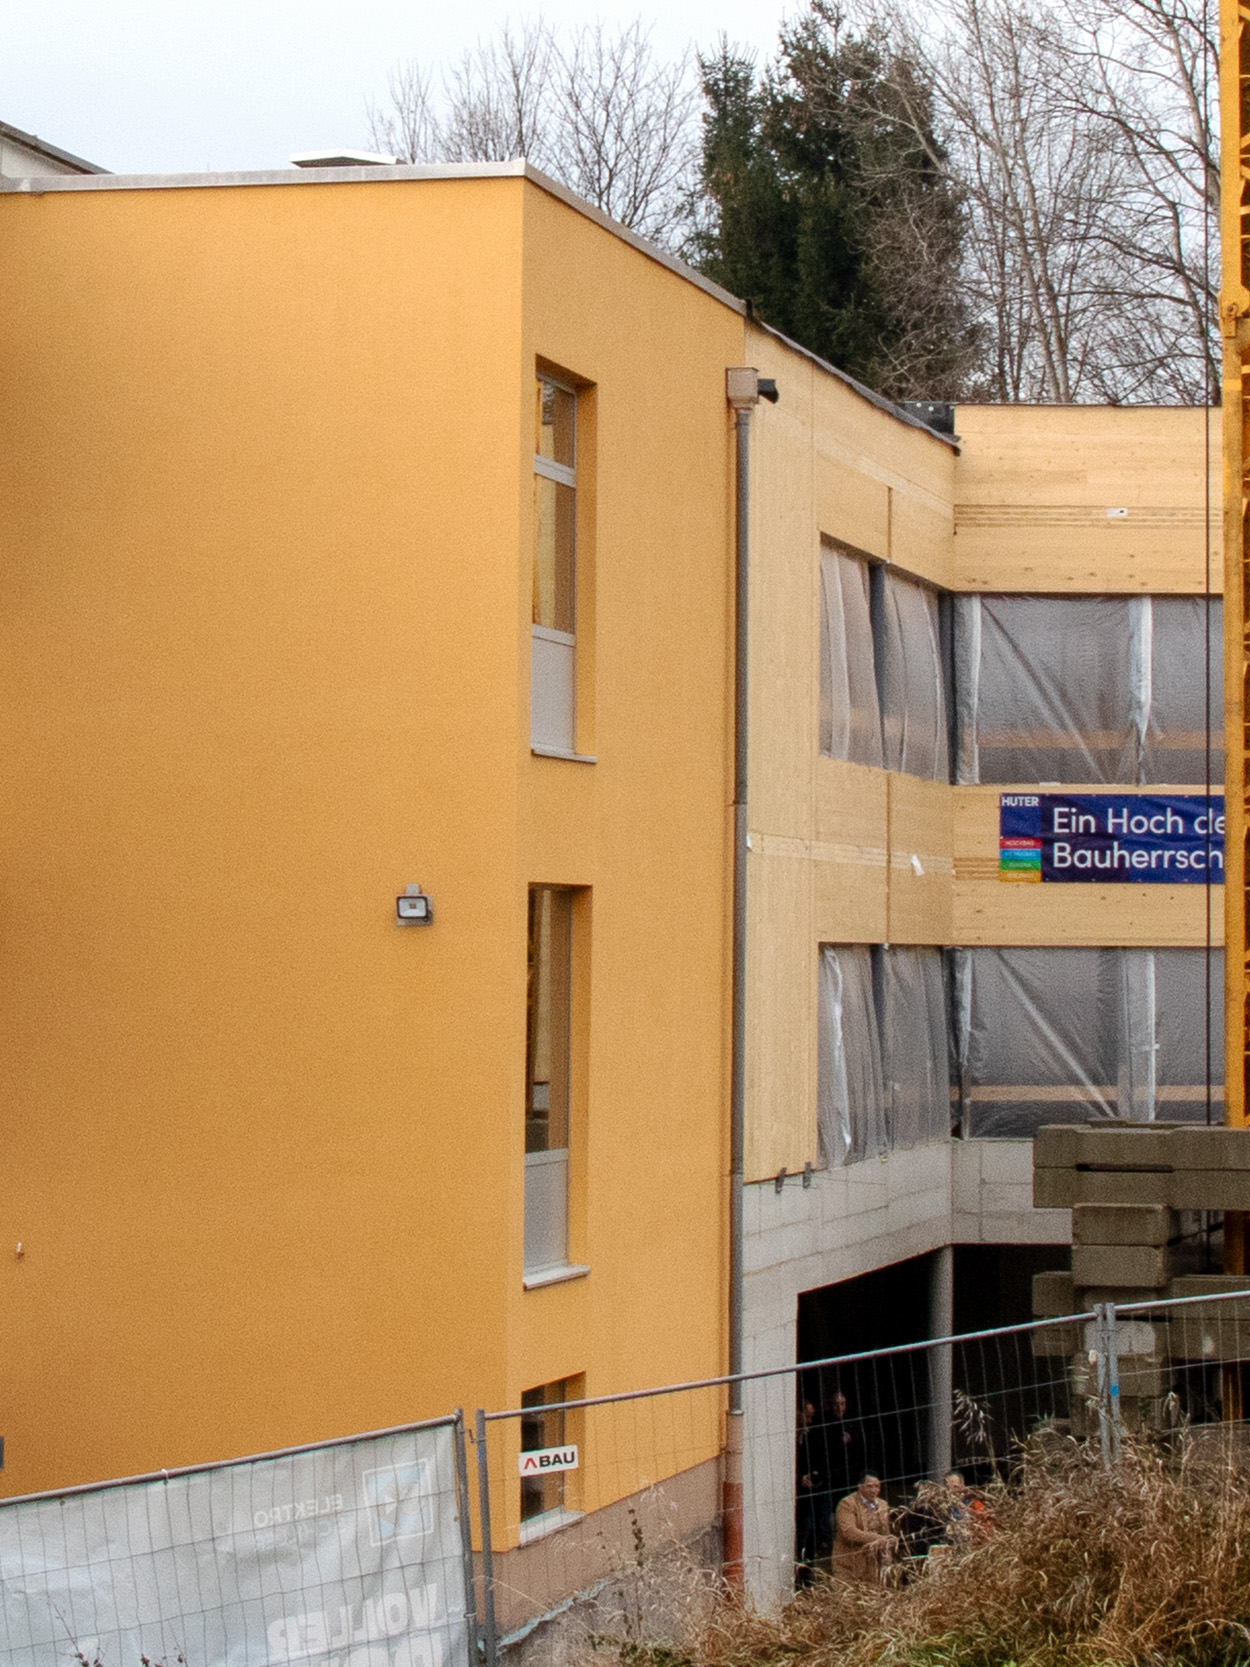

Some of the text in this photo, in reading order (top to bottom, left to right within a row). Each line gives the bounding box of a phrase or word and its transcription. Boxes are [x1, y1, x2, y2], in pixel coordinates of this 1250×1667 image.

[1001, 796, 1040, 807] HUTER
[1053, 807, 1226, 834] Ein Hoch de
